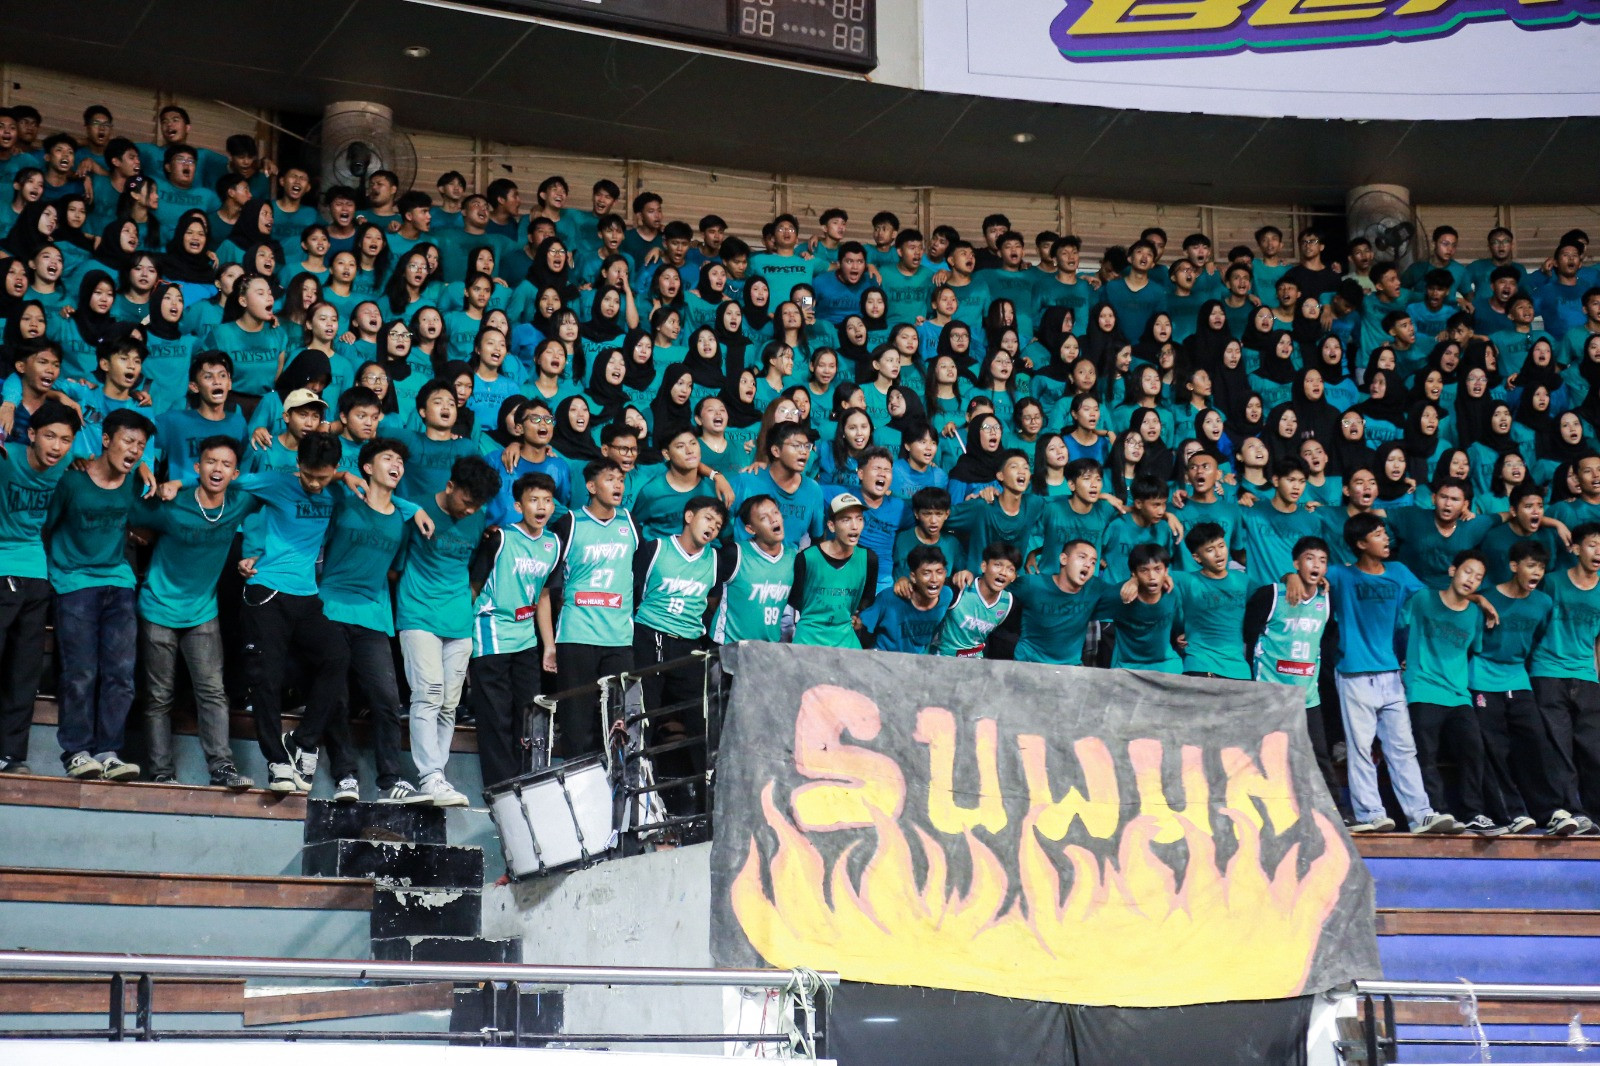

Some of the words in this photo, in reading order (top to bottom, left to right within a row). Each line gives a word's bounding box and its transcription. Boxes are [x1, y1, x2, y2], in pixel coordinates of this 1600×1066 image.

[763, 264, 807, 274] TWYSTER
[8, 484, 53, 512] TWYST
[583, 540, 628, 565] TWENTY
[590, 569, 614, 589] 27
[764, 607, 780, 625] 89
[791, 684, 1300, 843] SUWUN
